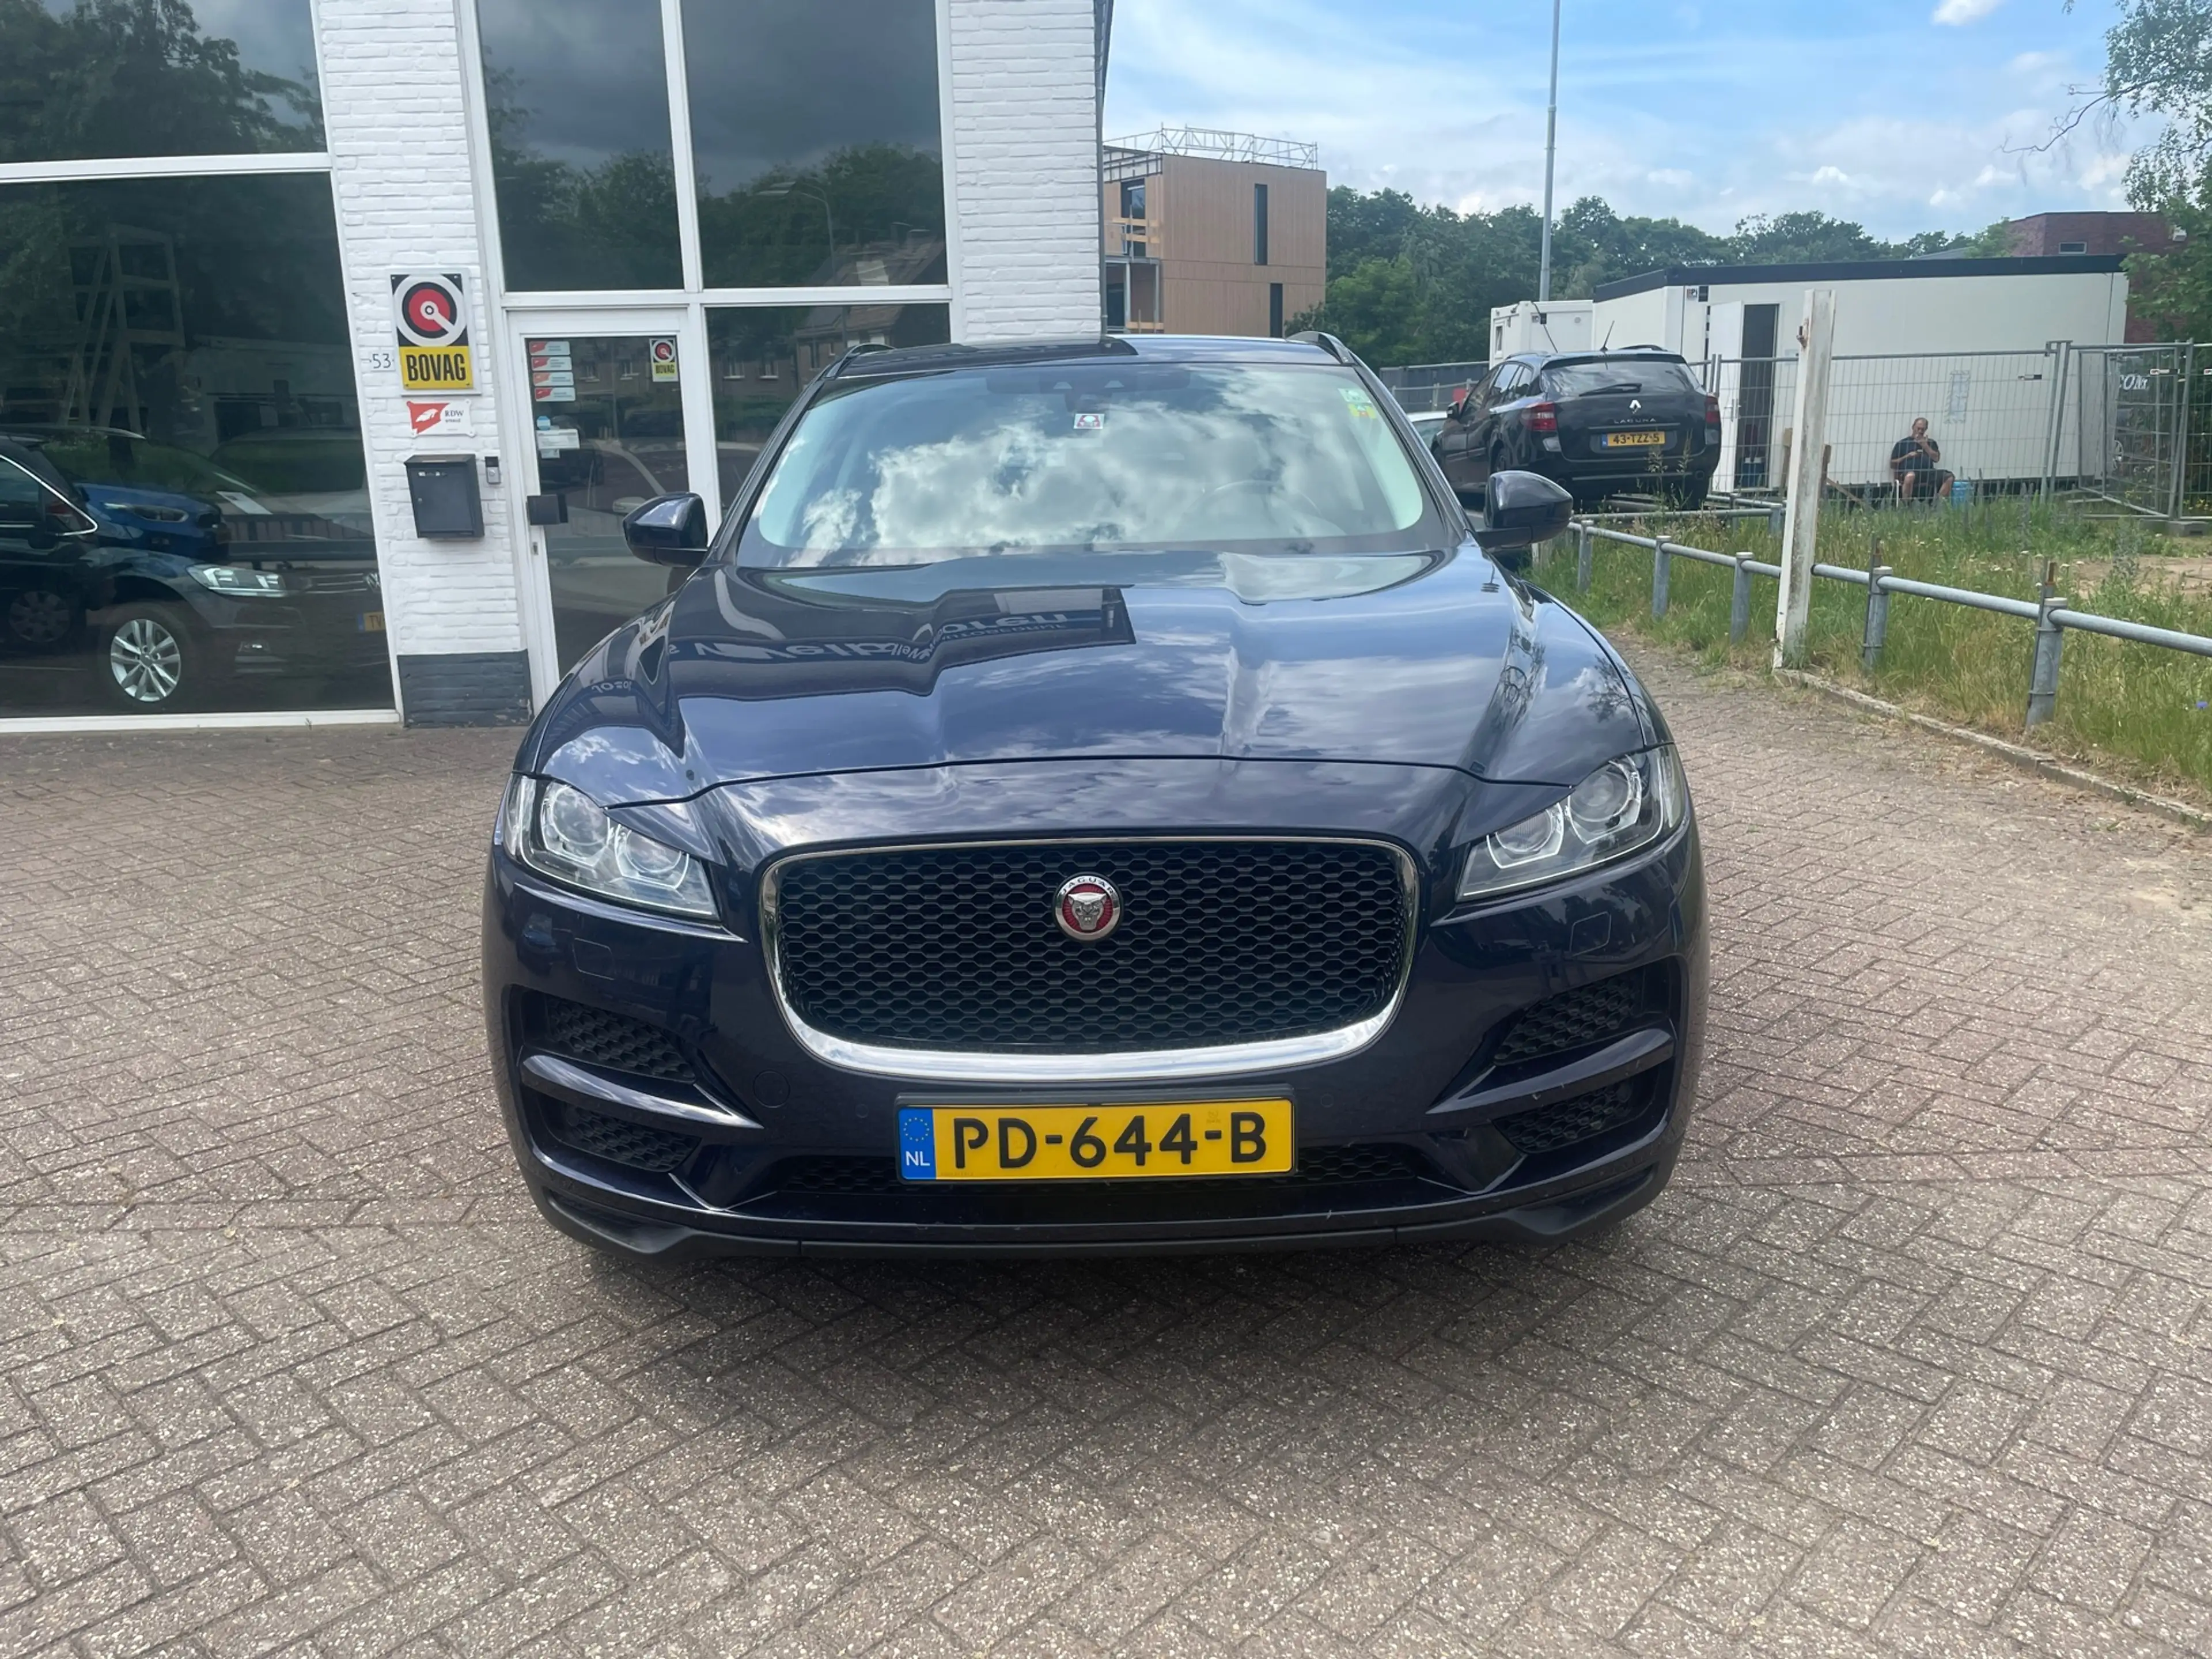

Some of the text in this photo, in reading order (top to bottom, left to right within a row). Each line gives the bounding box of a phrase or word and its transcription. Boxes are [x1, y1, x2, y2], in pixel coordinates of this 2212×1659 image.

[372, 353, 391, 369] 53
[406, 354, 466, 382] BOVAG
[1061, 876, 1115, 896] JAGUAR
[954, 1112, 1267, 1169] PD-644-B
[905, 1151, 931, 1166] NL
